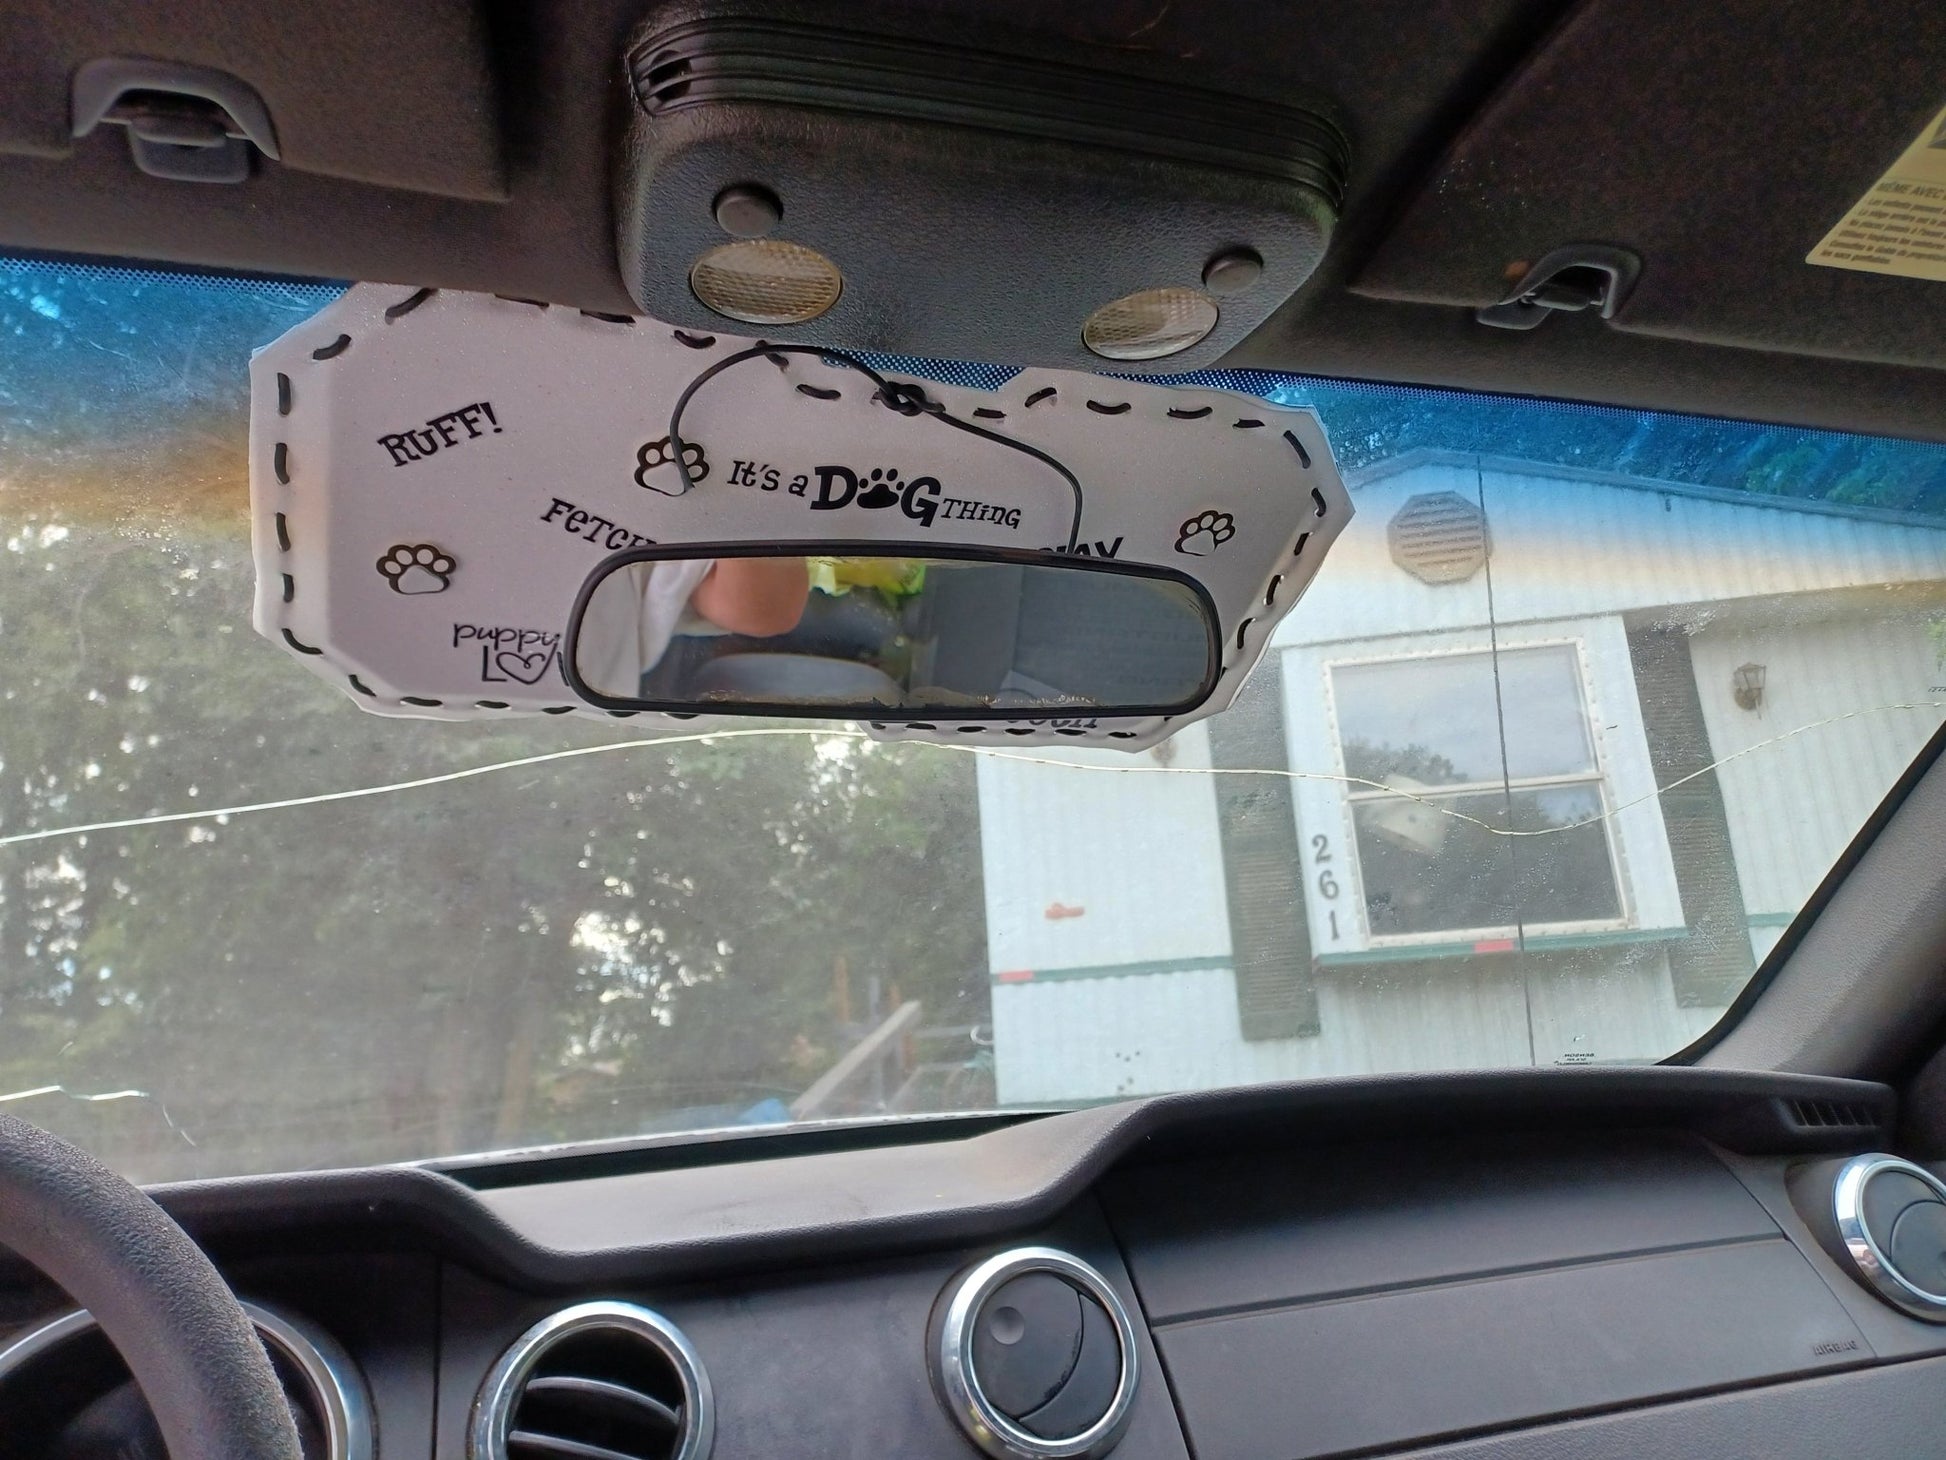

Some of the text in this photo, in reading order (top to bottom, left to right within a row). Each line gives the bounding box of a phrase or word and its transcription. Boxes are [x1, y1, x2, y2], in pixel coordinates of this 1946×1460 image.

[377, 402, 503, 467] RUFF!
[727, 460, 781, 492] It's
[788, 474, 809, 498] a
[1312, 834, 1340, 941] 261
[1813, 1340, 1859, 1356] AIRBAG
